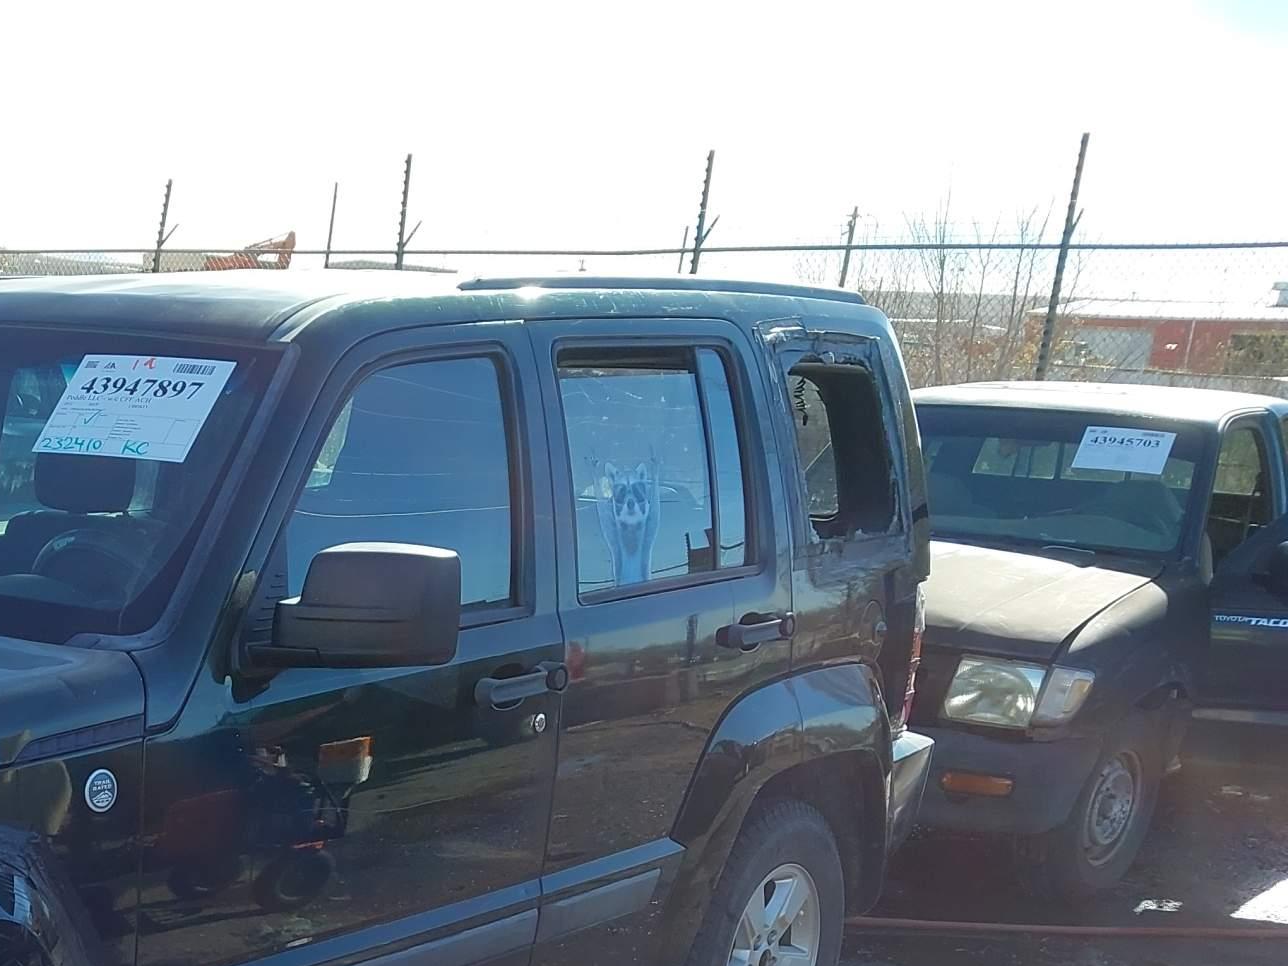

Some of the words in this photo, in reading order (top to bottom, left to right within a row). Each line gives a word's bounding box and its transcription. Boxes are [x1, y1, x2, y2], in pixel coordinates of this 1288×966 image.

[81, 376, 206, 400] 43947897
[42, 437, 103, 452] 232410
[121, 440, 150, 456] KC
[1090, 435, 1161, 449] 43945703
[1214, 615, 1248, 623] TOYOTA
[93, 778, 112, 786] TRAIL
